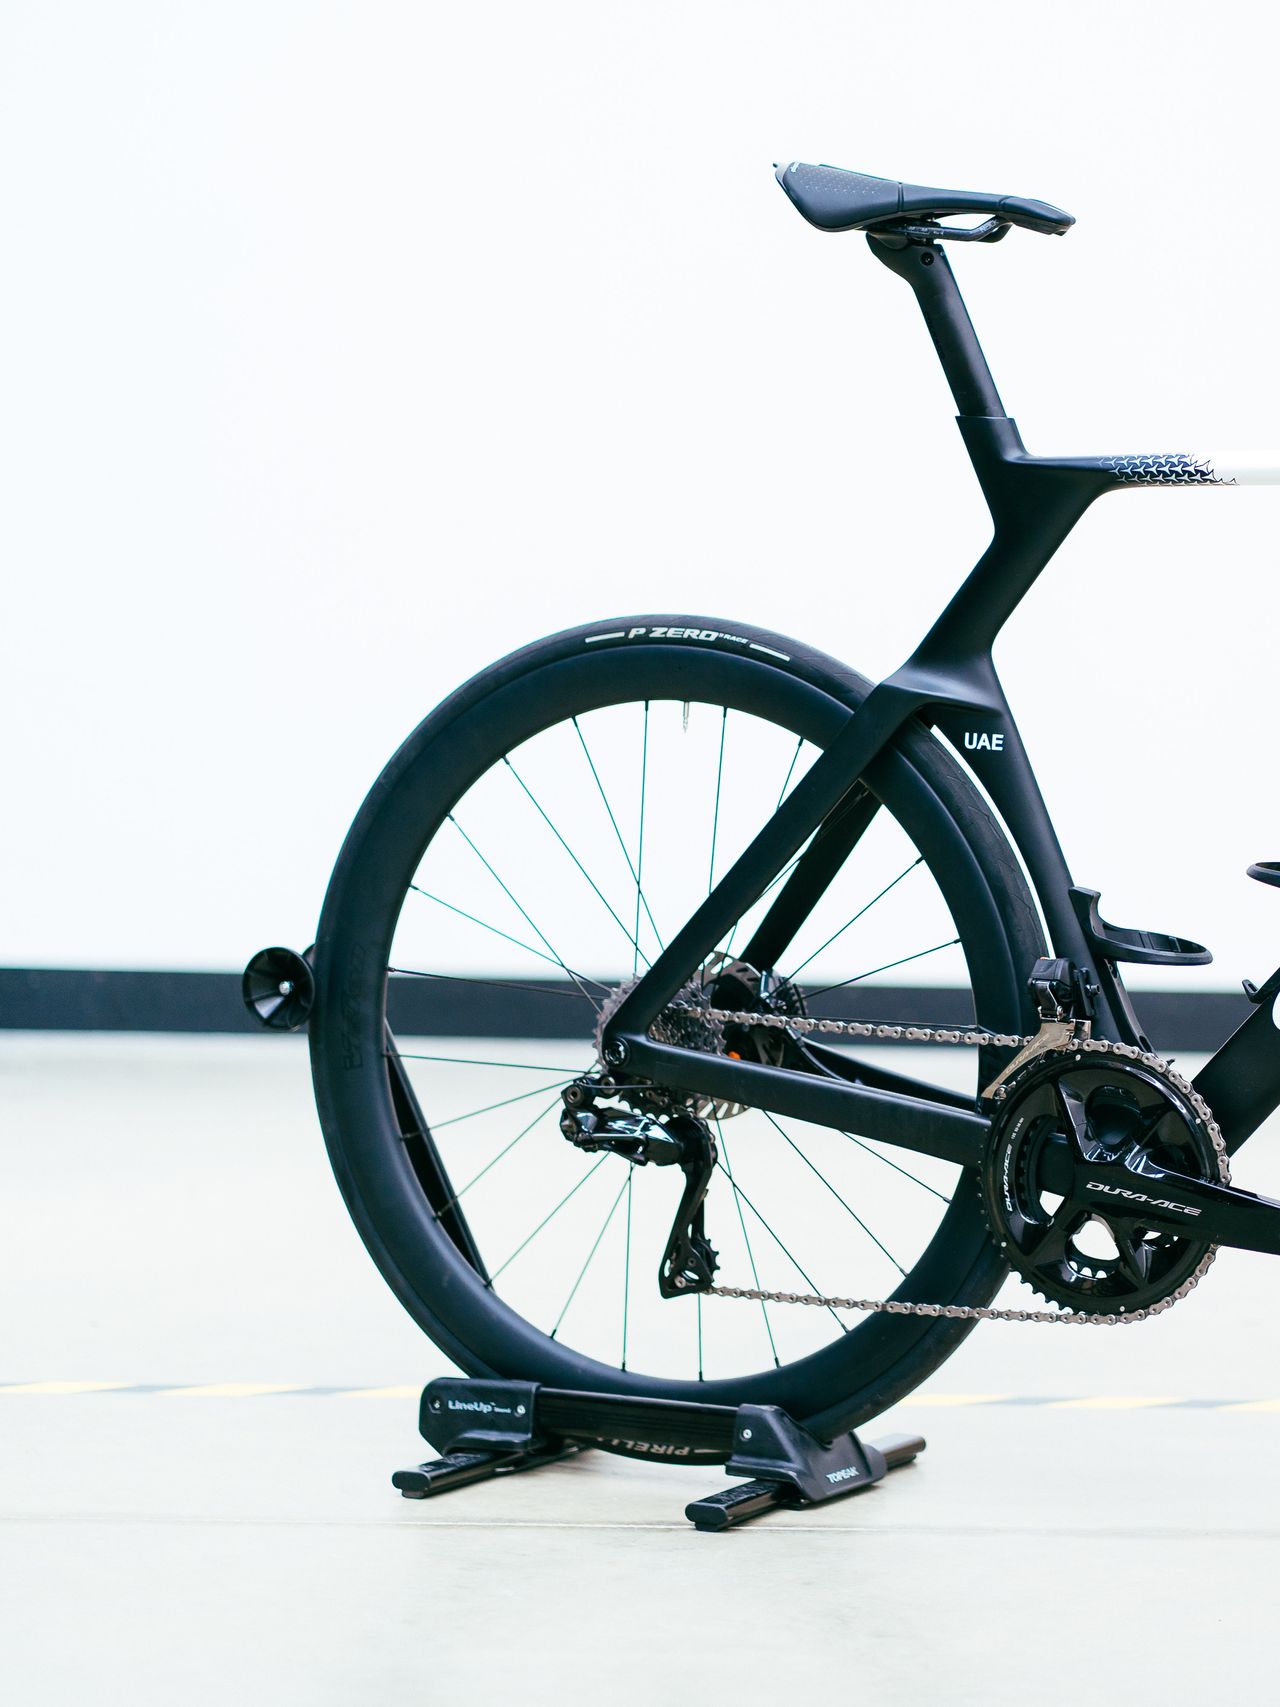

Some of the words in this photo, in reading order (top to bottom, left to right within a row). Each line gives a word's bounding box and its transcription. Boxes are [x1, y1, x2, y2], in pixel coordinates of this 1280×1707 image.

[629, 629, 646, 639] P
[649, 628, 719, 641] ZERO
[964, 732, 1004, 751] UAE
[999, 1143, 1013, 1213] DURA-ACE
[1086, 1181, 1203, 1217] DURA-ACE
[447, 1400, 493, 1414] LineUp
